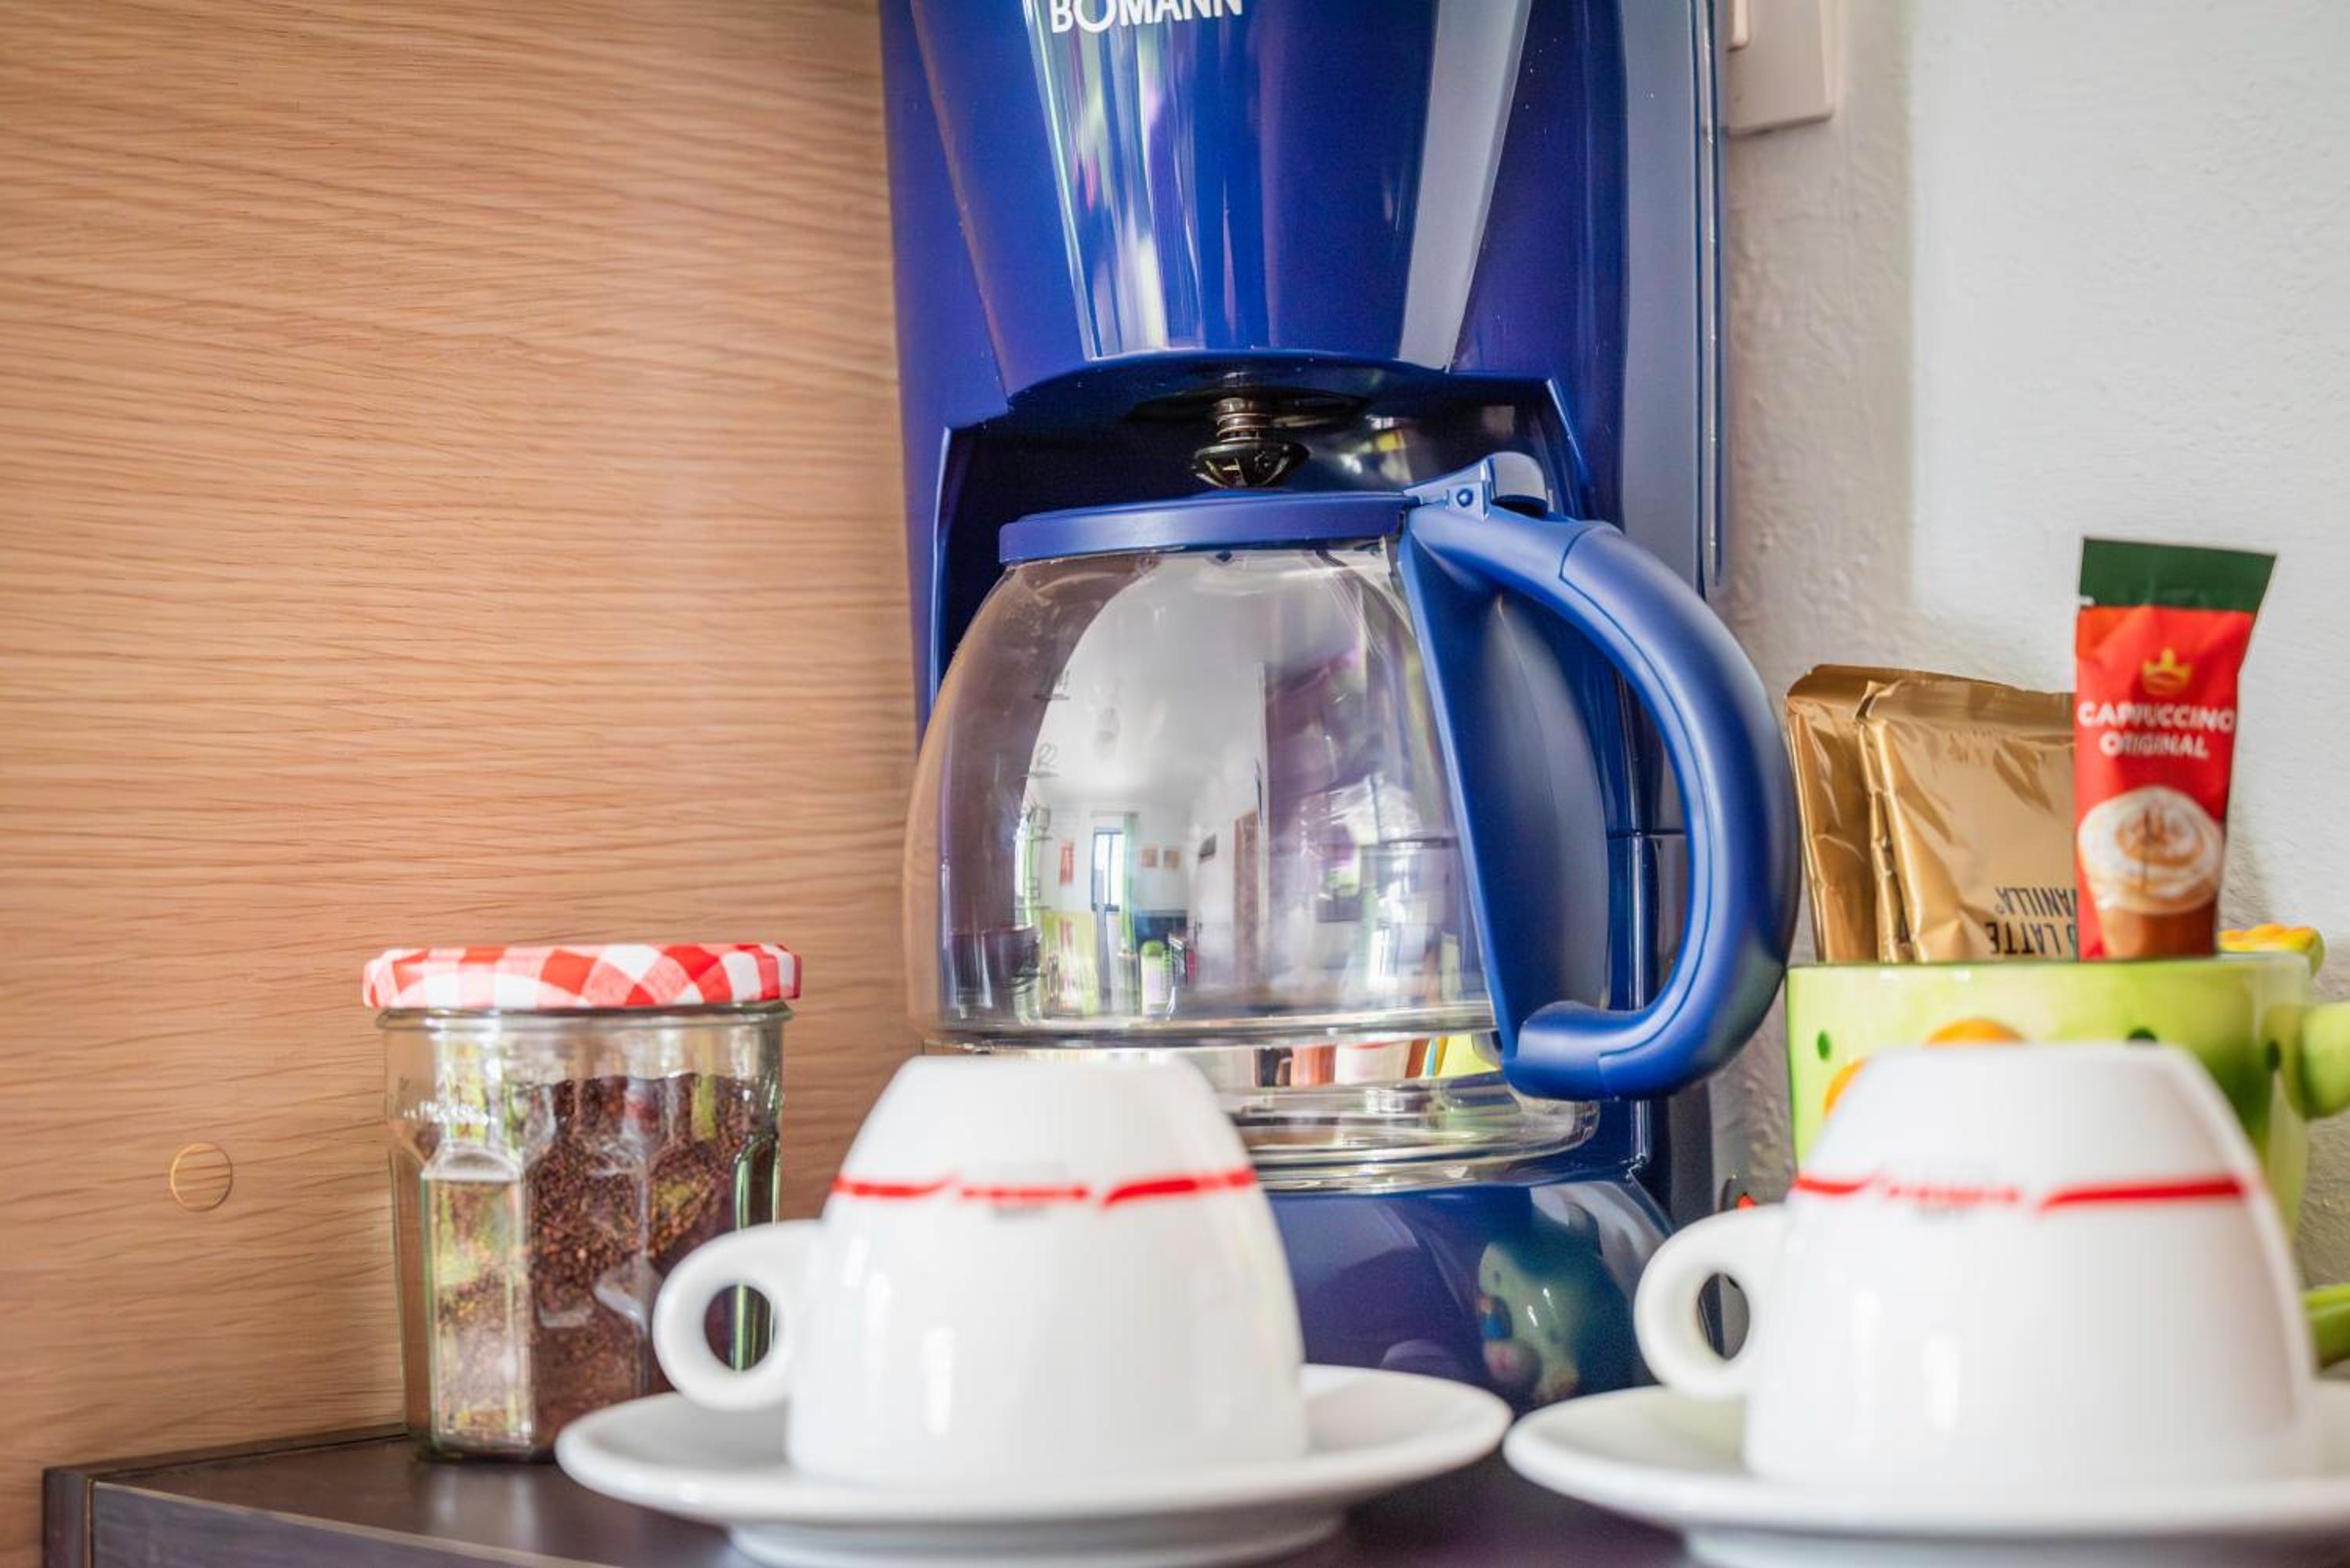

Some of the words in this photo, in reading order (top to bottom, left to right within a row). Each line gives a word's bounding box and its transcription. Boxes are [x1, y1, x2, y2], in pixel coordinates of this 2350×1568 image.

[2077, 700, 2236, 732] CAPPUCCINO
[2099, 732, 2209, 758] ORIGINAL
[1985, 921, 2062, 954] LATTE
